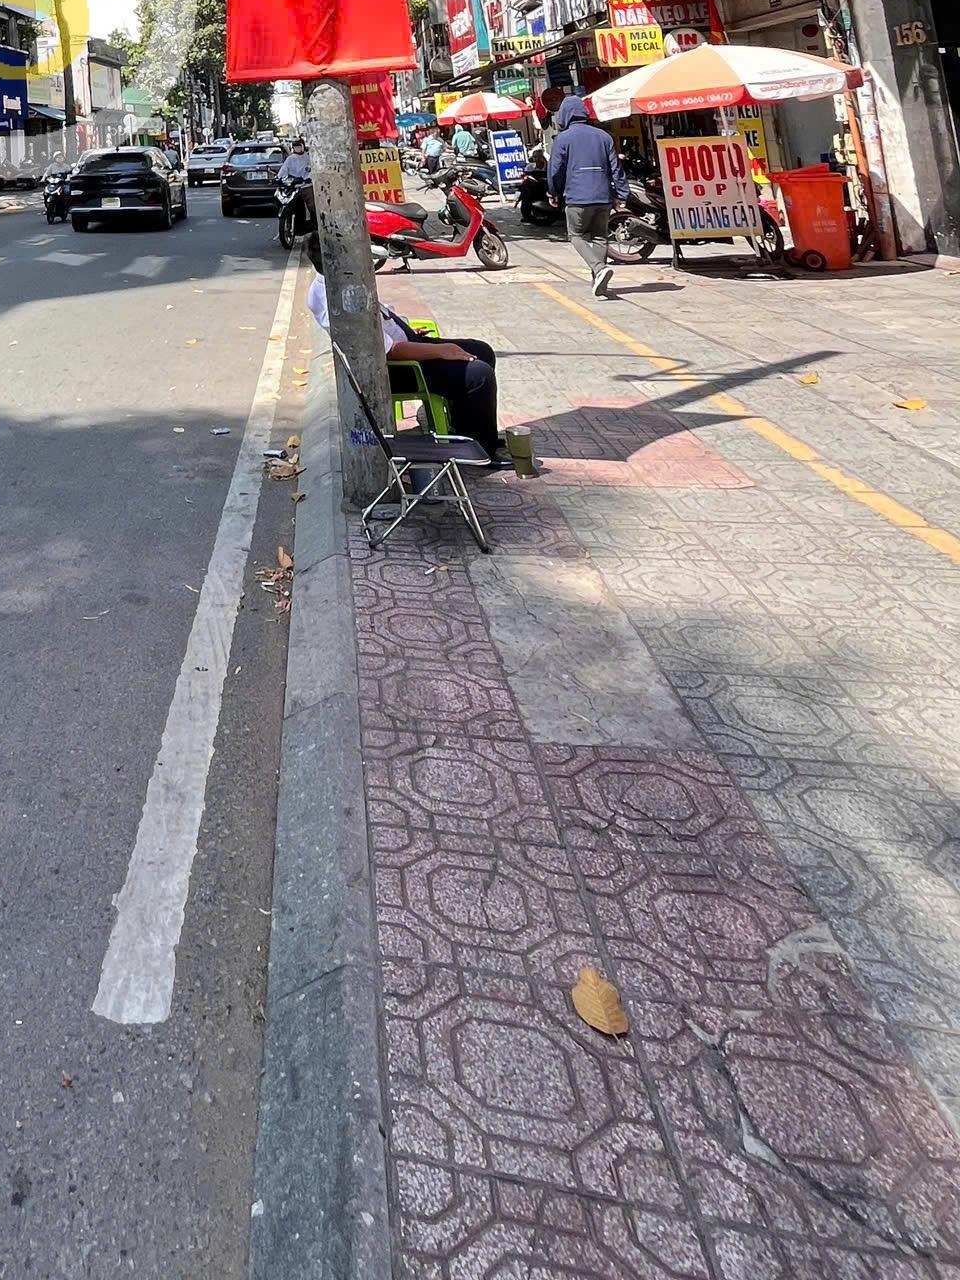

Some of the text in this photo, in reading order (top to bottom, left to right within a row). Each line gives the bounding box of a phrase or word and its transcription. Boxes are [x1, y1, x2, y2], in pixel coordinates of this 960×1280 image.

[652, 4, 685, 23] KEO
[686, 2, 709, 20] XE
[677, 33, 698, 46] IN
[893, 21, 928, 48] 156
[599, 33, 629, 65] IN
[631, 41, 661, 52] DECAL
[660, 99, 680, 108] 1900
[365, 151, 397, 164] DECAL
[665, 142, 747, 183] PHOTO
[672, 207, 686, 230] IN
[689, 200, 730, 230] QUẢNG
